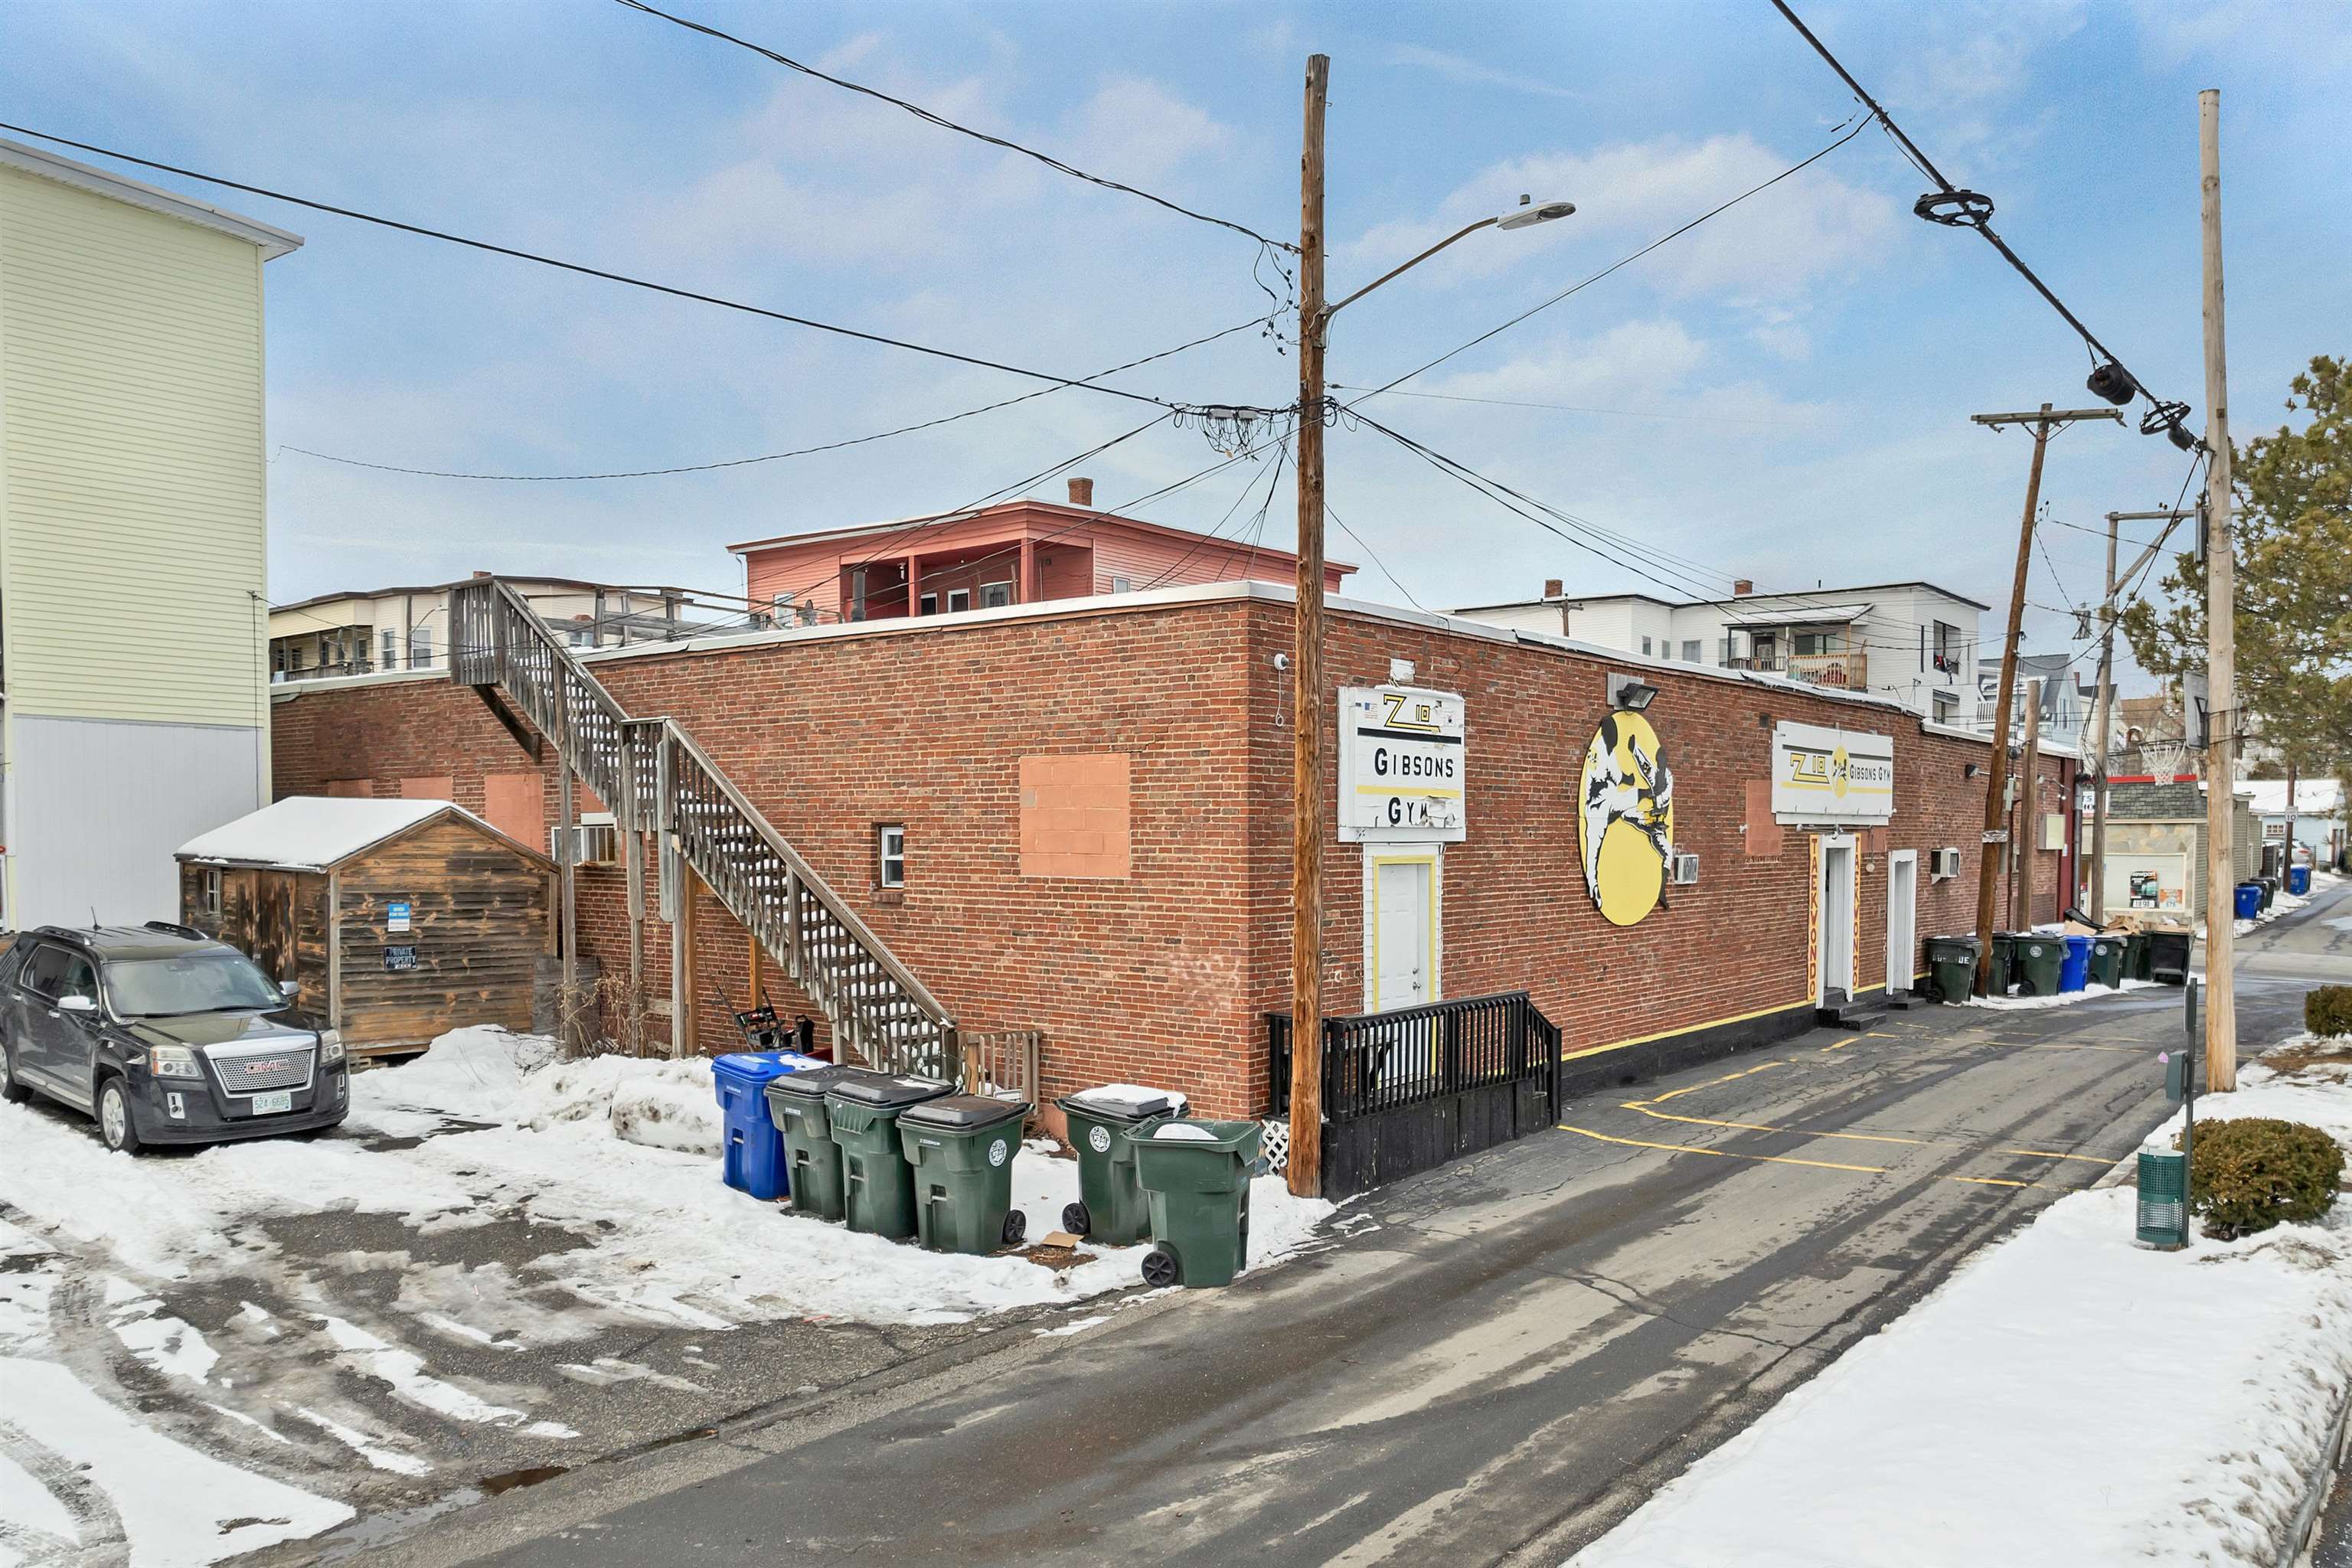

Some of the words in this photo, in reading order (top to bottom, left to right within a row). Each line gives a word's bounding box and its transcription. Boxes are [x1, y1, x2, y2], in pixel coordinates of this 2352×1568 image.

[1374, 747, 1454, 778] GIBSONS
[1850, 764, 1877, 781] GIBSONS
[1879, 766, 1890, 781] GYM
[1810, 838, 1818, 996] TAEKWONDO
[390, 948, 413, 956] PRIVATE
[385, 956, 416, 964] PROPERTY
[246, 1061, 289, 1072] GMC
